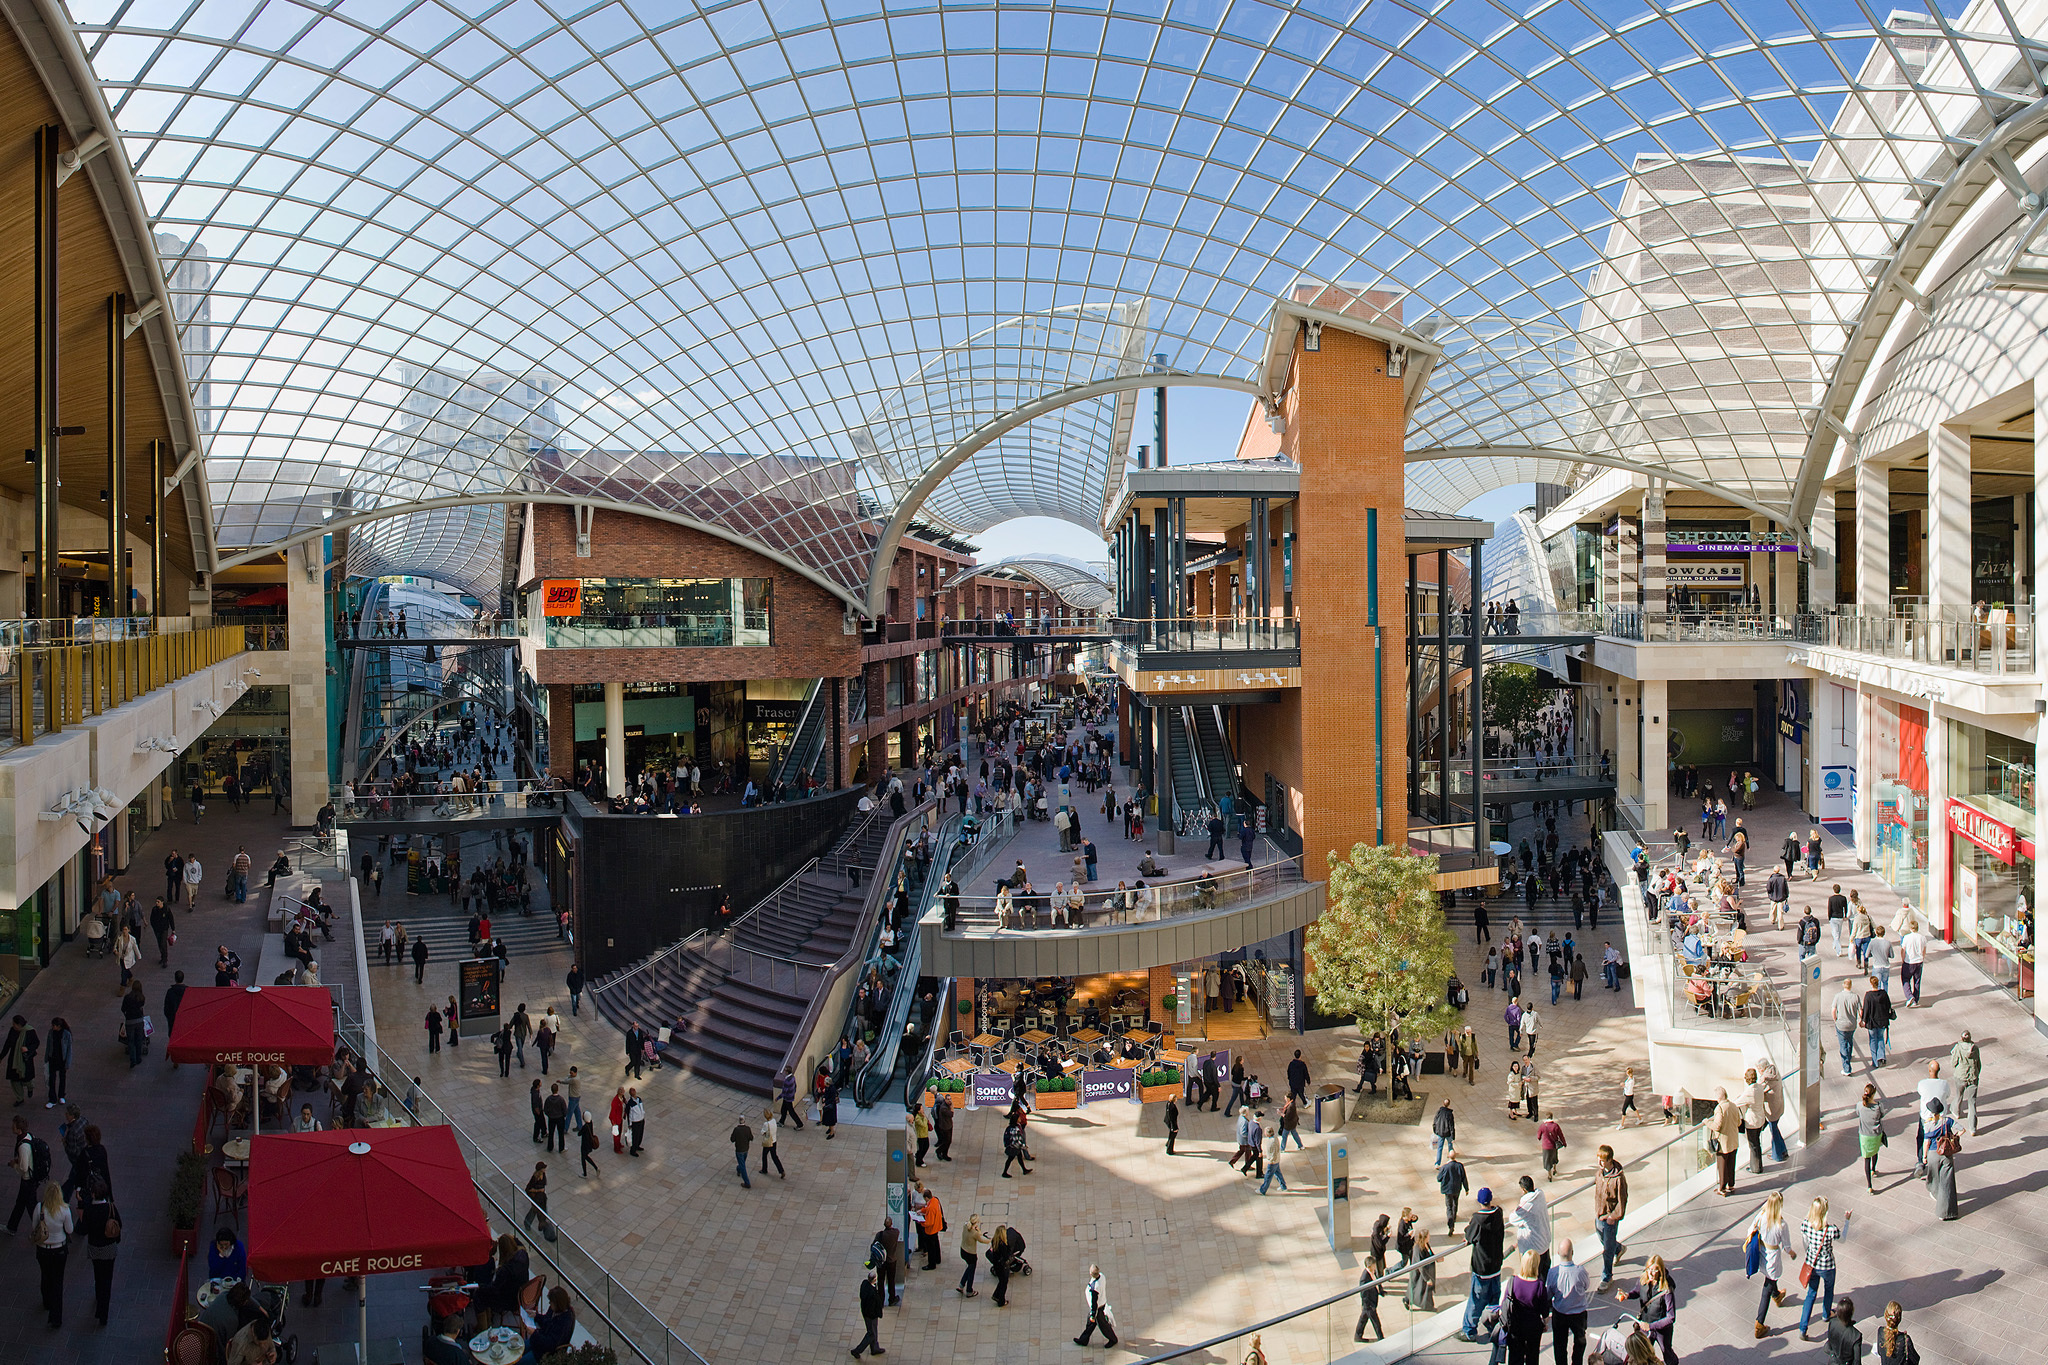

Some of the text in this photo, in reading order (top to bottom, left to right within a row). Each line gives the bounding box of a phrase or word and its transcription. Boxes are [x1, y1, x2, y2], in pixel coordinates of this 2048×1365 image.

[1666, 531, 1795, 542] SHOWCAS
[1697, 544, 1782, 552] CINEMA DE LUX
[1667, 567, 1742, 575] OWCASE
[1980, 559, 2011, 576] Zizzi
[547, 587, 578, 602] YO!
[92, 596, 101, 617] asca
[756, 704, 797, 718] Fraser
[215, 1051, 286, 1062] CAFÉ ROUGE
[976, 1087, 1006, 1096] SOHO
[1085, 1081, 1115, 1092] SOHO
[320, 1254, 423, 1274] CAFÉ ROUGE
